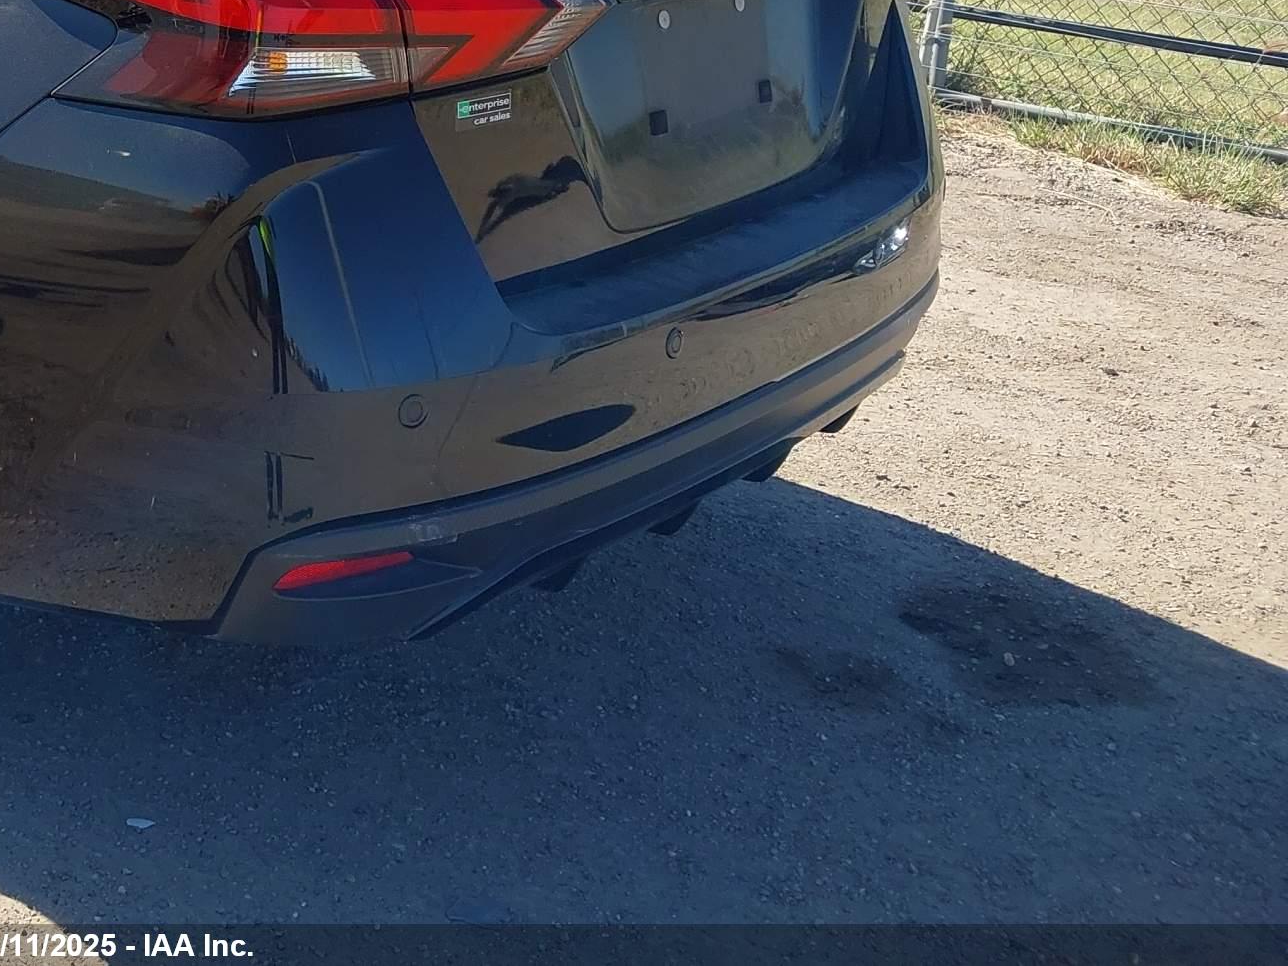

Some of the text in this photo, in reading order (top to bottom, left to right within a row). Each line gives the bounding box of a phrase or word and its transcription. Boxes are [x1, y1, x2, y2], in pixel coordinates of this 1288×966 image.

[461, 98, 510, 113] enterprise
[473, 111, 511, 125] car sales
